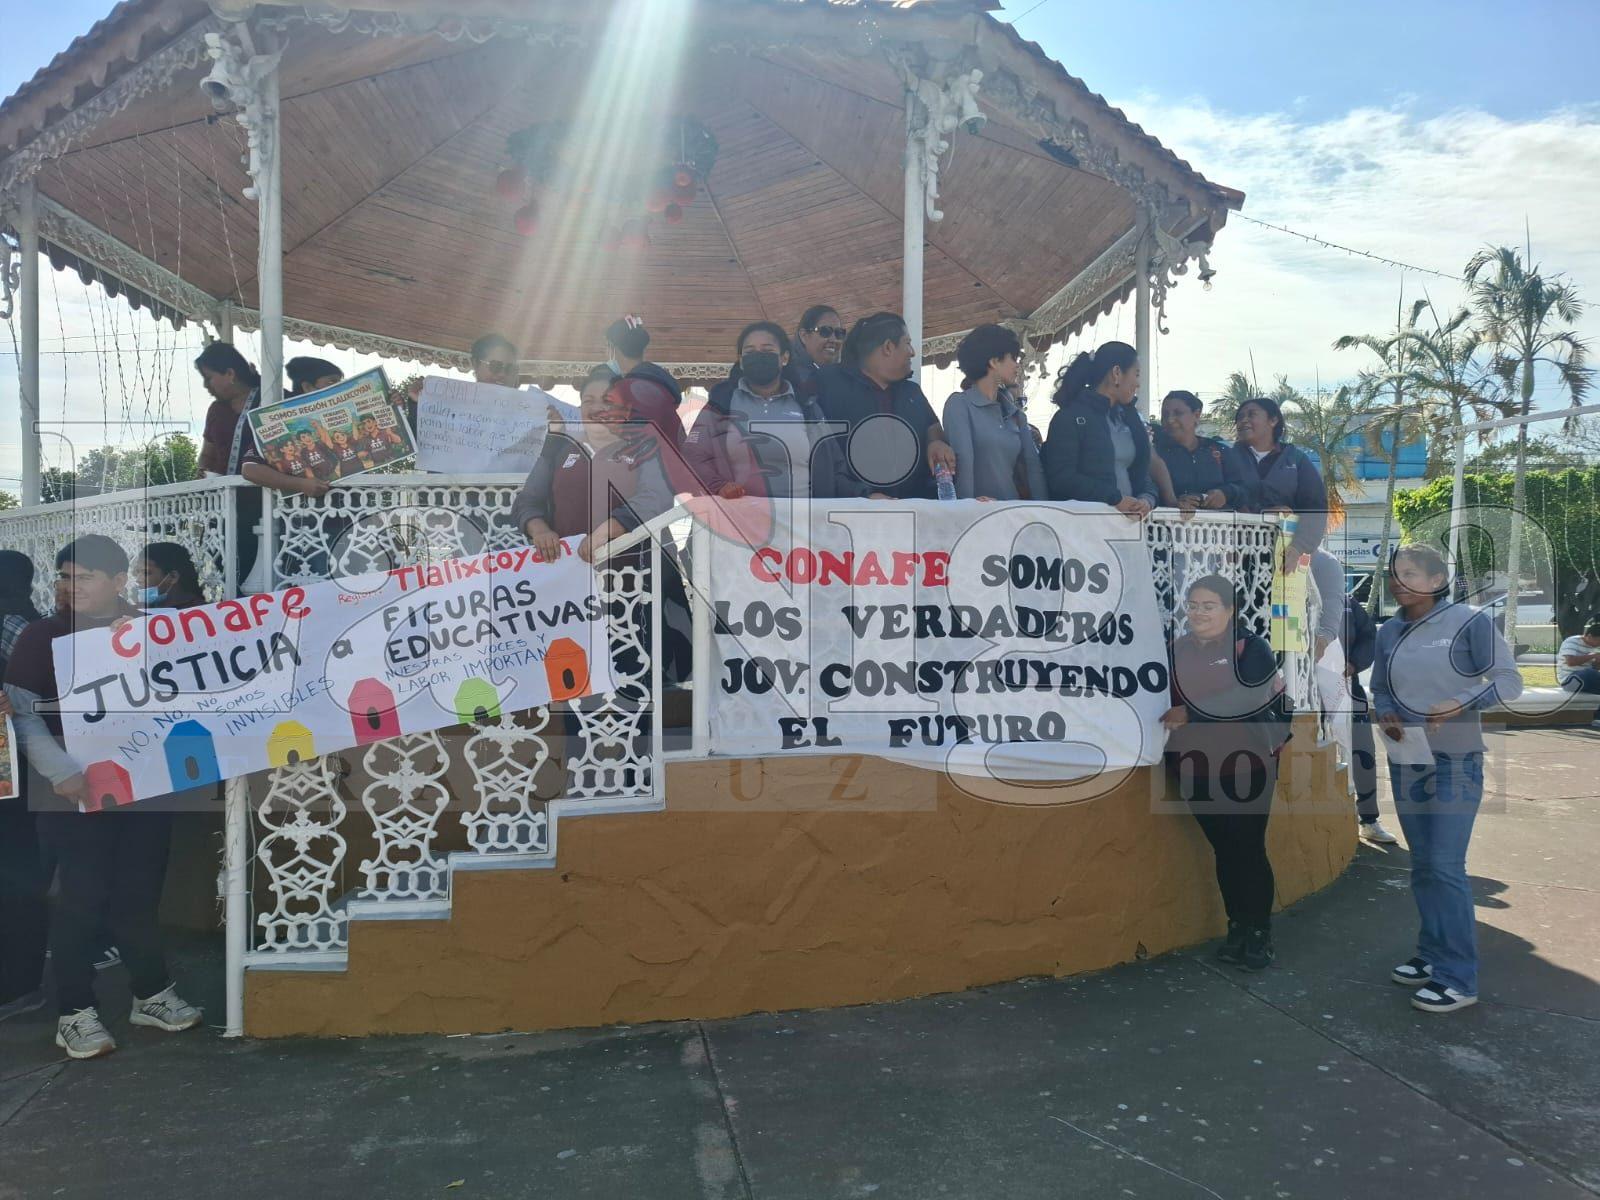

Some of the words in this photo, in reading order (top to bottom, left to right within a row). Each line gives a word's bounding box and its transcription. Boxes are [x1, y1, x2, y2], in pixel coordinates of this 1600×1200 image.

[269, 408, 298, 421] SOMOS
[749, 547, 950, 587] CONAFE
[980, 554, 1110, 594] SOMOS
[383, 580, 537, 632] FIGURAS
[387, 594, 602, 664] EDUCATIVAS
[714, 600, 802, 641] LOS
[841, 604, 1134, 645] VERDADEROS
[73, 632, 301, 723] JUSTICIA
[330, 637, 354, 658] a
[385, 652, 463, 681] NUESTRAS
[477, 639, 527, 656] VOCES
[537, 633, 545, 645] Y
[398, 671, 452, 693] LABOR
[463, 647, 547, 679] IMPORTAN
[721, 656, 810, 695] JOV.
[819, 658, 1168, 698] CONSTRUYENDO
[215, 689, 265, 718] SOMOS
[225, 676, 335, 737] INVISIBLES
[778, 716, 842, 750] EL
[888, 711, 1066, 748] FUTURO
